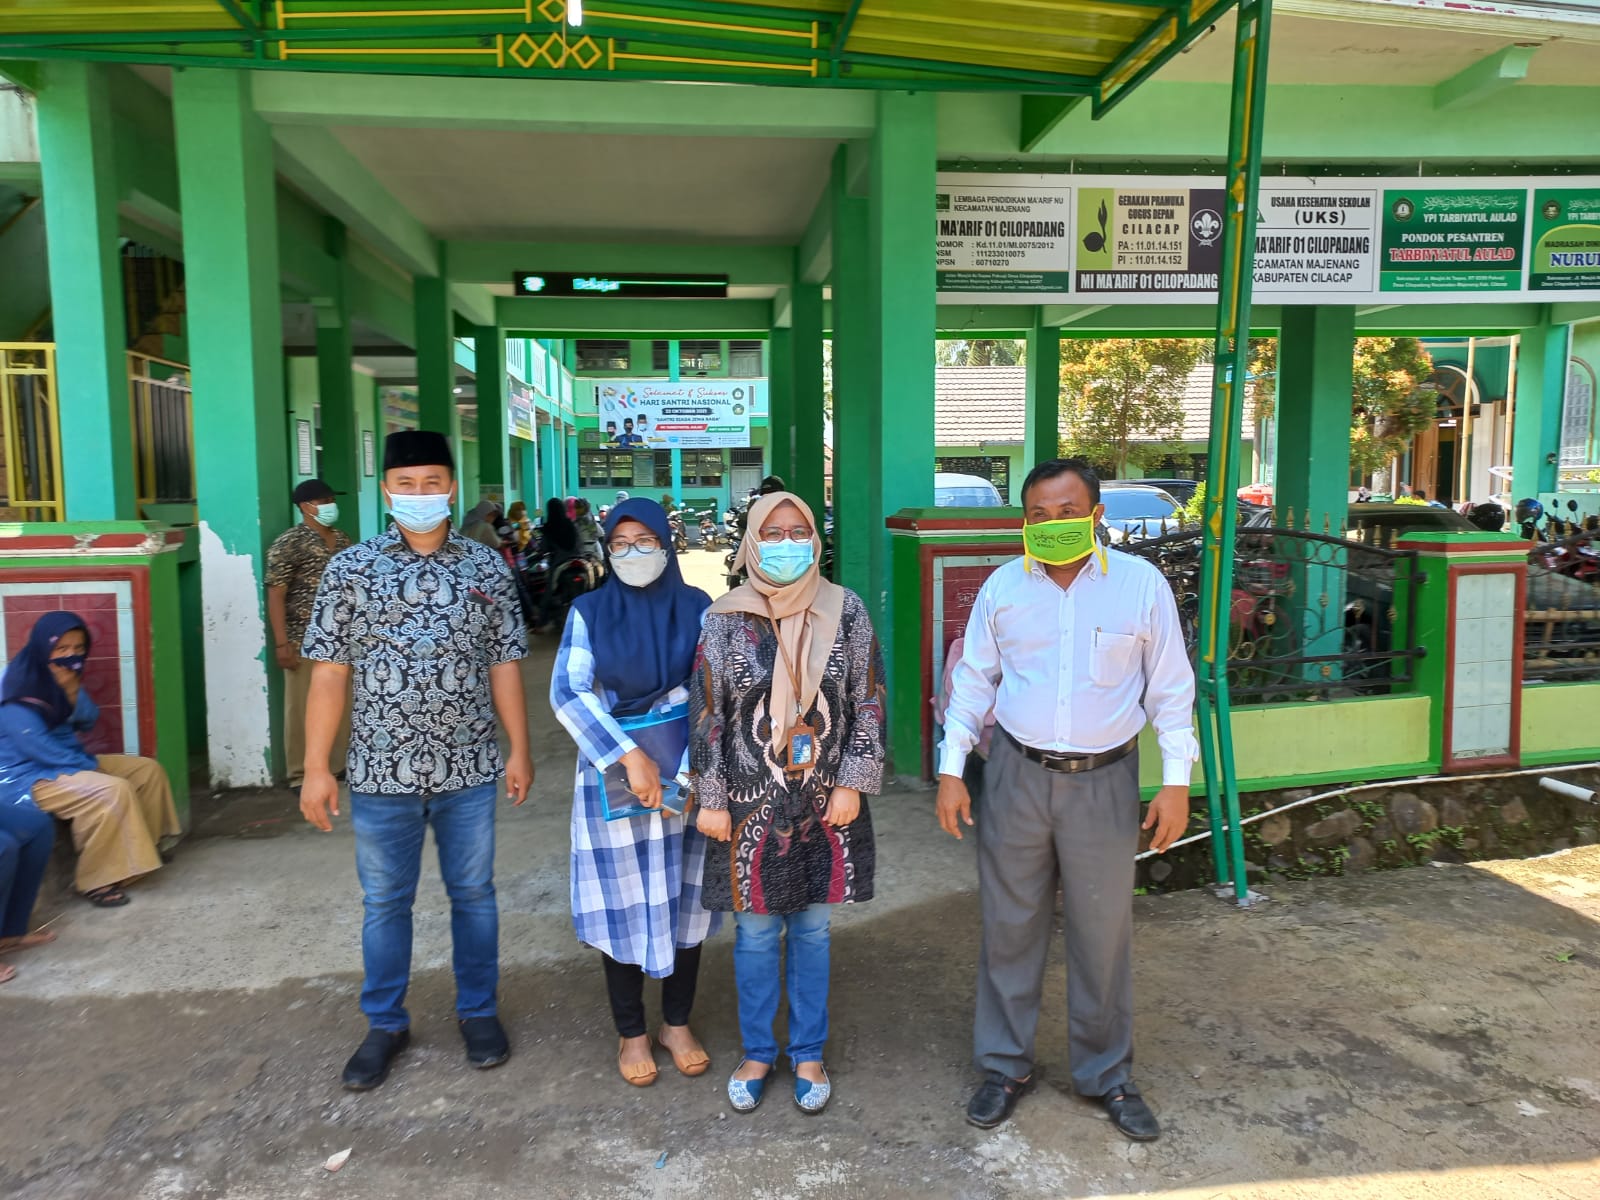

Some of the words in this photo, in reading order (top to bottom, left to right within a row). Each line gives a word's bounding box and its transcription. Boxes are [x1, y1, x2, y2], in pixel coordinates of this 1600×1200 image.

[954, 195, 986, 203] LEMBAGA
[987, 196, 1026, 204] PENDIDIKAN
[1118, 195, 1151, 206] GERAKAN
[1151, 196, 1185, 206] PRAMUKA
[1271, 197, 1296, 207] USAHA
[1297, 197, 1337, 207] KESEHATAN
[1338, 197, 1371, 207] SEKOLAH
[995, 205, 1031, 213] MAJENANG
[1153, 209, 1174, 219] DEPAN
[1423, 213, 1437, 223] YPI
[1439, 213, 1488, 223] TARBIYATUL
[1489, 212, 1518, 222] AULAD
[940, 220, 983, 236] MA'ARIF
[985, 221, 997, 237] 01
[999, 221, 1065, 237] CILOPADANG
[1401, 233, 1445, 243] PONDOK
[1447, 233, 1505, 242] PESANTREN
[1118, 241, 1129, 250] PA
[1136, 241, 1182, 250] 11.01.14.151
[1293, 237, 1305, 253] 01
[1307, 237, 1370, 253] CILOPADANG
[976, 250, 1026, 258] 111233010075
[1473, 247, 1516, 262] AULAD
[1118, 256, 1126, 265] PI
[1136, 256, 1182, 265] 11.01.14.152
[1253, 259, 1303, 269] ECAMATAN
[1306, 259, 1360, 269] MAJENANG
[1080, 274, 1093, 289] MI
[1095, 274, 1138, 289] MA'ARIF
[1140, 274, 1152, 289] 01
[1154, 274, 1219, 289] CILOPADANG
[1252, 273, 1308, 283] KABUPATEN
[1311, 273, 1353, 283] CILACAP
